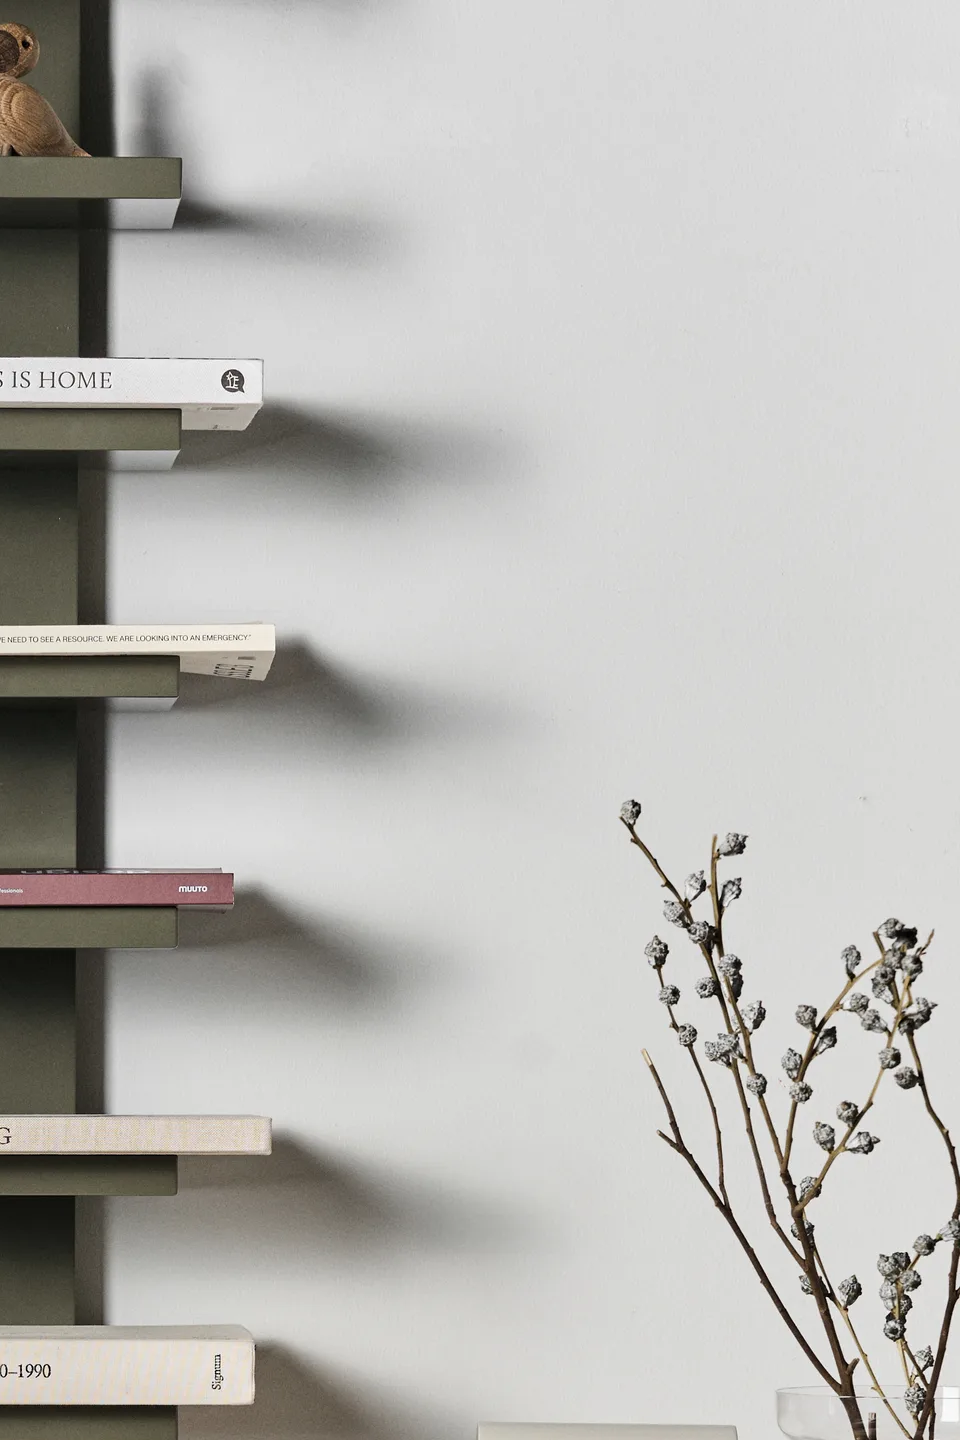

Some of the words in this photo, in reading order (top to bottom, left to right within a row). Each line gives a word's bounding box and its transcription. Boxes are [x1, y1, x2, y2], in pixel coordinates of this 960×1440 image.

[11, 370, 31, 389] IS
[38, 370, 113, 389] HOME
[6, 636, 28, 644] NEED
[28, 635, 39, 643] TO
[39, 635, 55, 643] SEE
[55, 635, 62, 643] A
[62, 635, 105, 643] RESOURCE.
[105, 635, 118, 643] WE
[118, 634, 134, 643] ARE
[135, 634, 170, 643] LOOKING
[170, 634, 189, 642] INTO
[189, 634, 201, 642] AN
[211, 1353, 224, 1391] Signum
